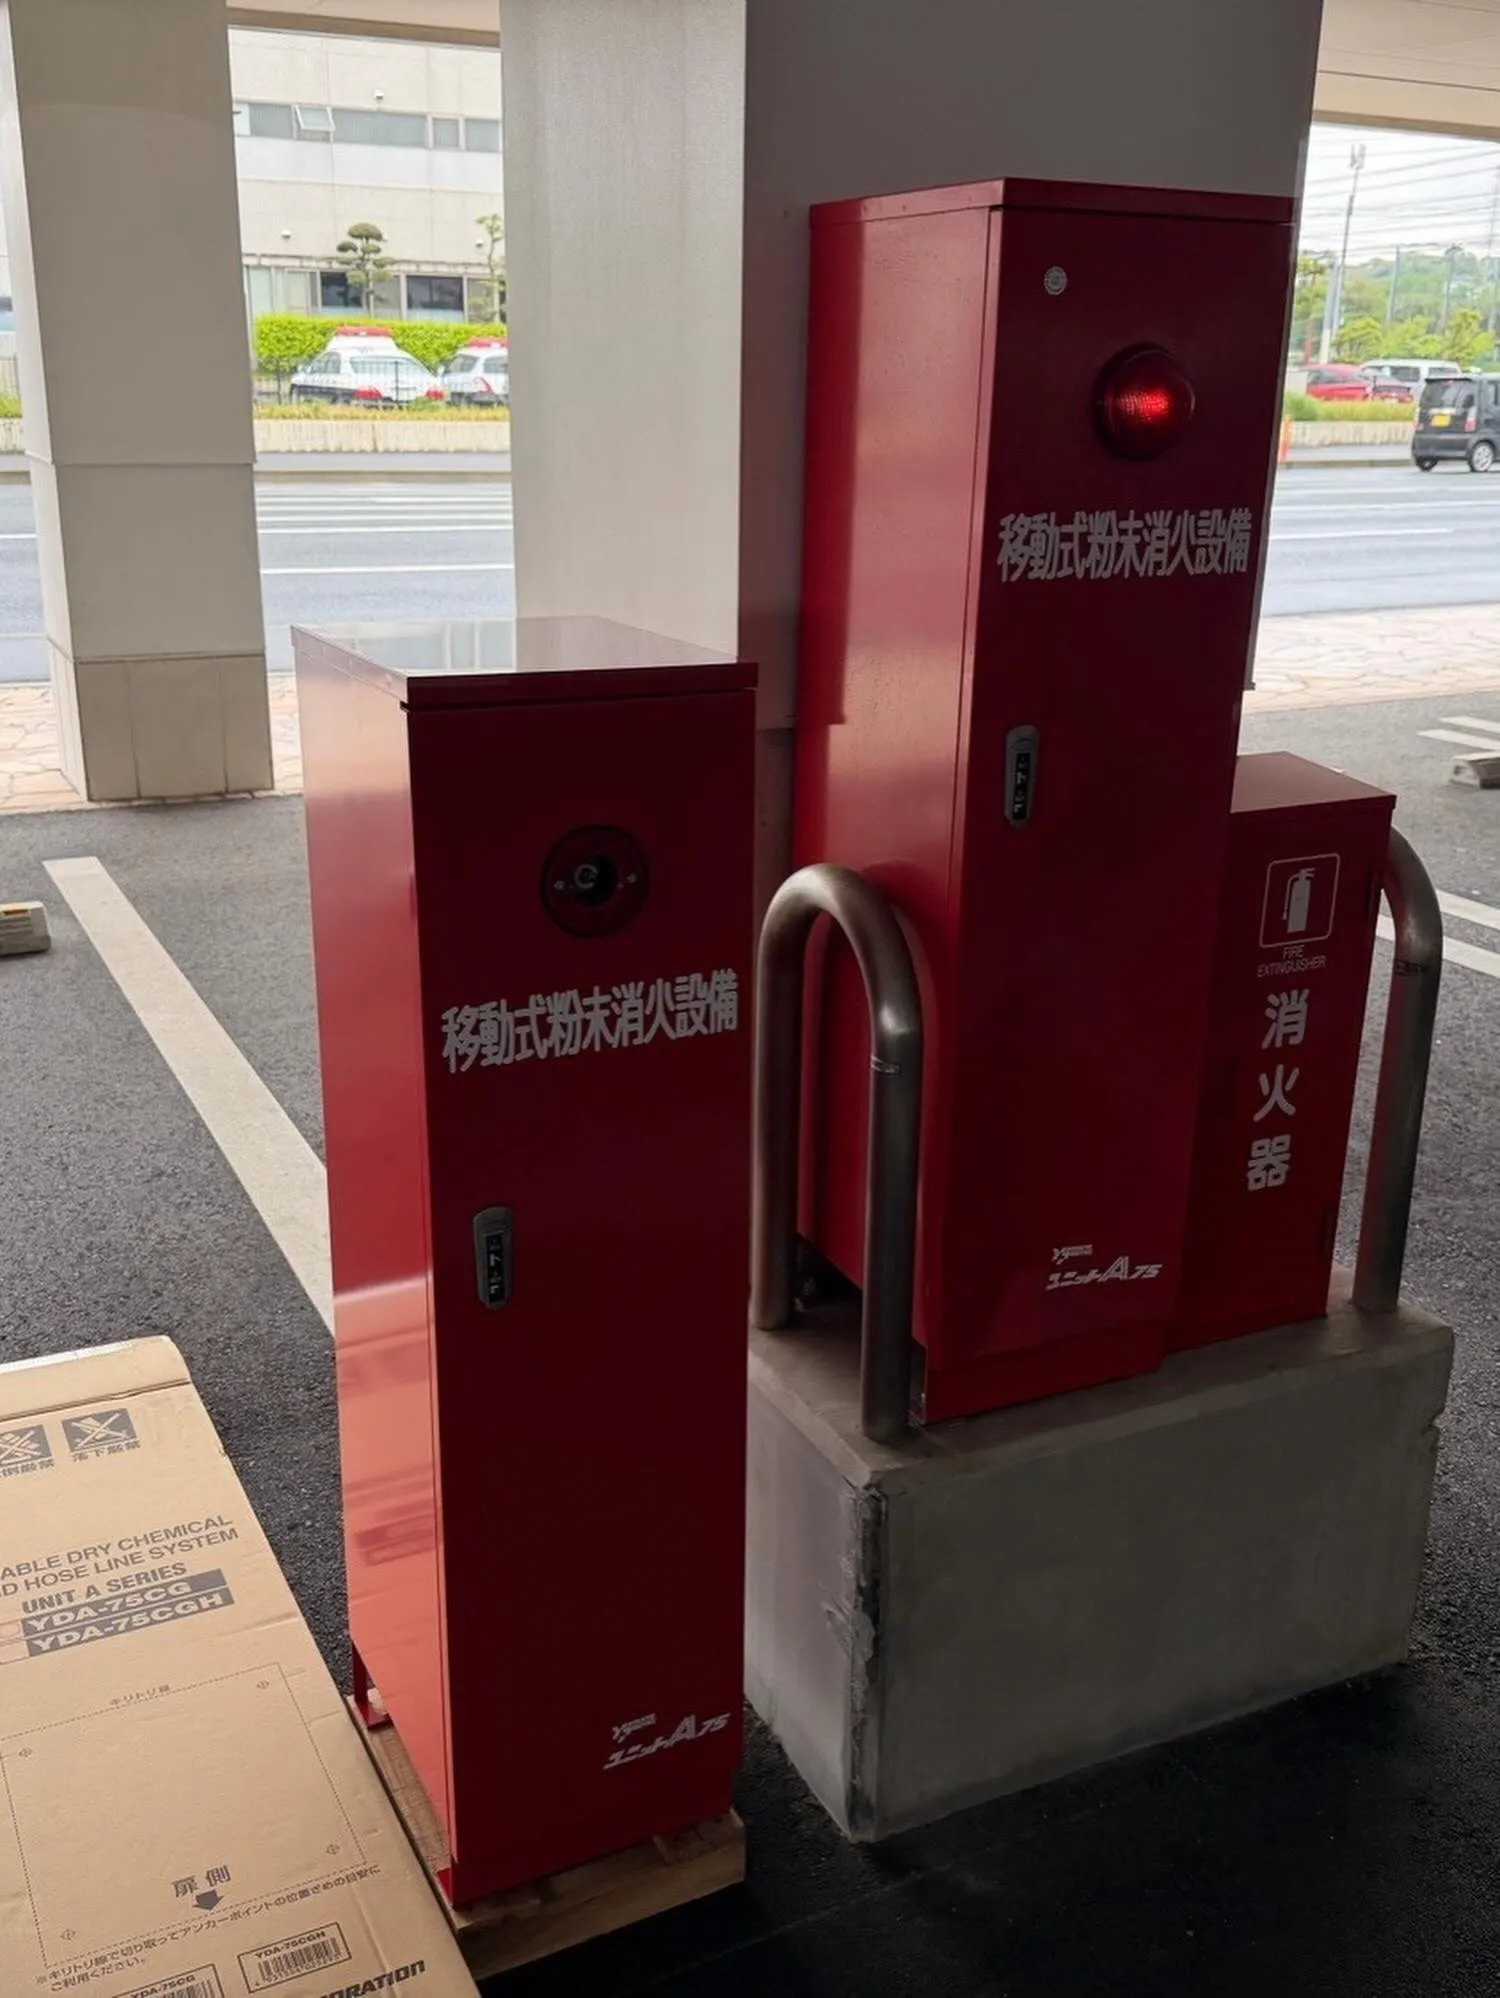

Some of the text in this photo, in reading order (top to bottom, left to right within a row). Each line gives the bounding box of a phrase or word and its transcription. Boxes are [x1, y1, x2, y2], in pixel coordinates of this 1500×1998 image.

[997, 508, 1252, 583] 移動式粉末消火設備
[441, 968, 738, 1073] 移動式粉末消火設備
[1247, 989, 1310, 1191] 消火器
[0, 1527, 239, 1598] D HOSE LINE SYSTEM
[66, 1542, 112, 1564] DRY
[117, 1515, 233, 1552] CHEMICAL
[22, 1562, 188, 1615] UNIT A SERIES
[28, 1581, 192, 1633] YDA-75CG
[33, 1591, 225, 1652] YDA-75CGH
